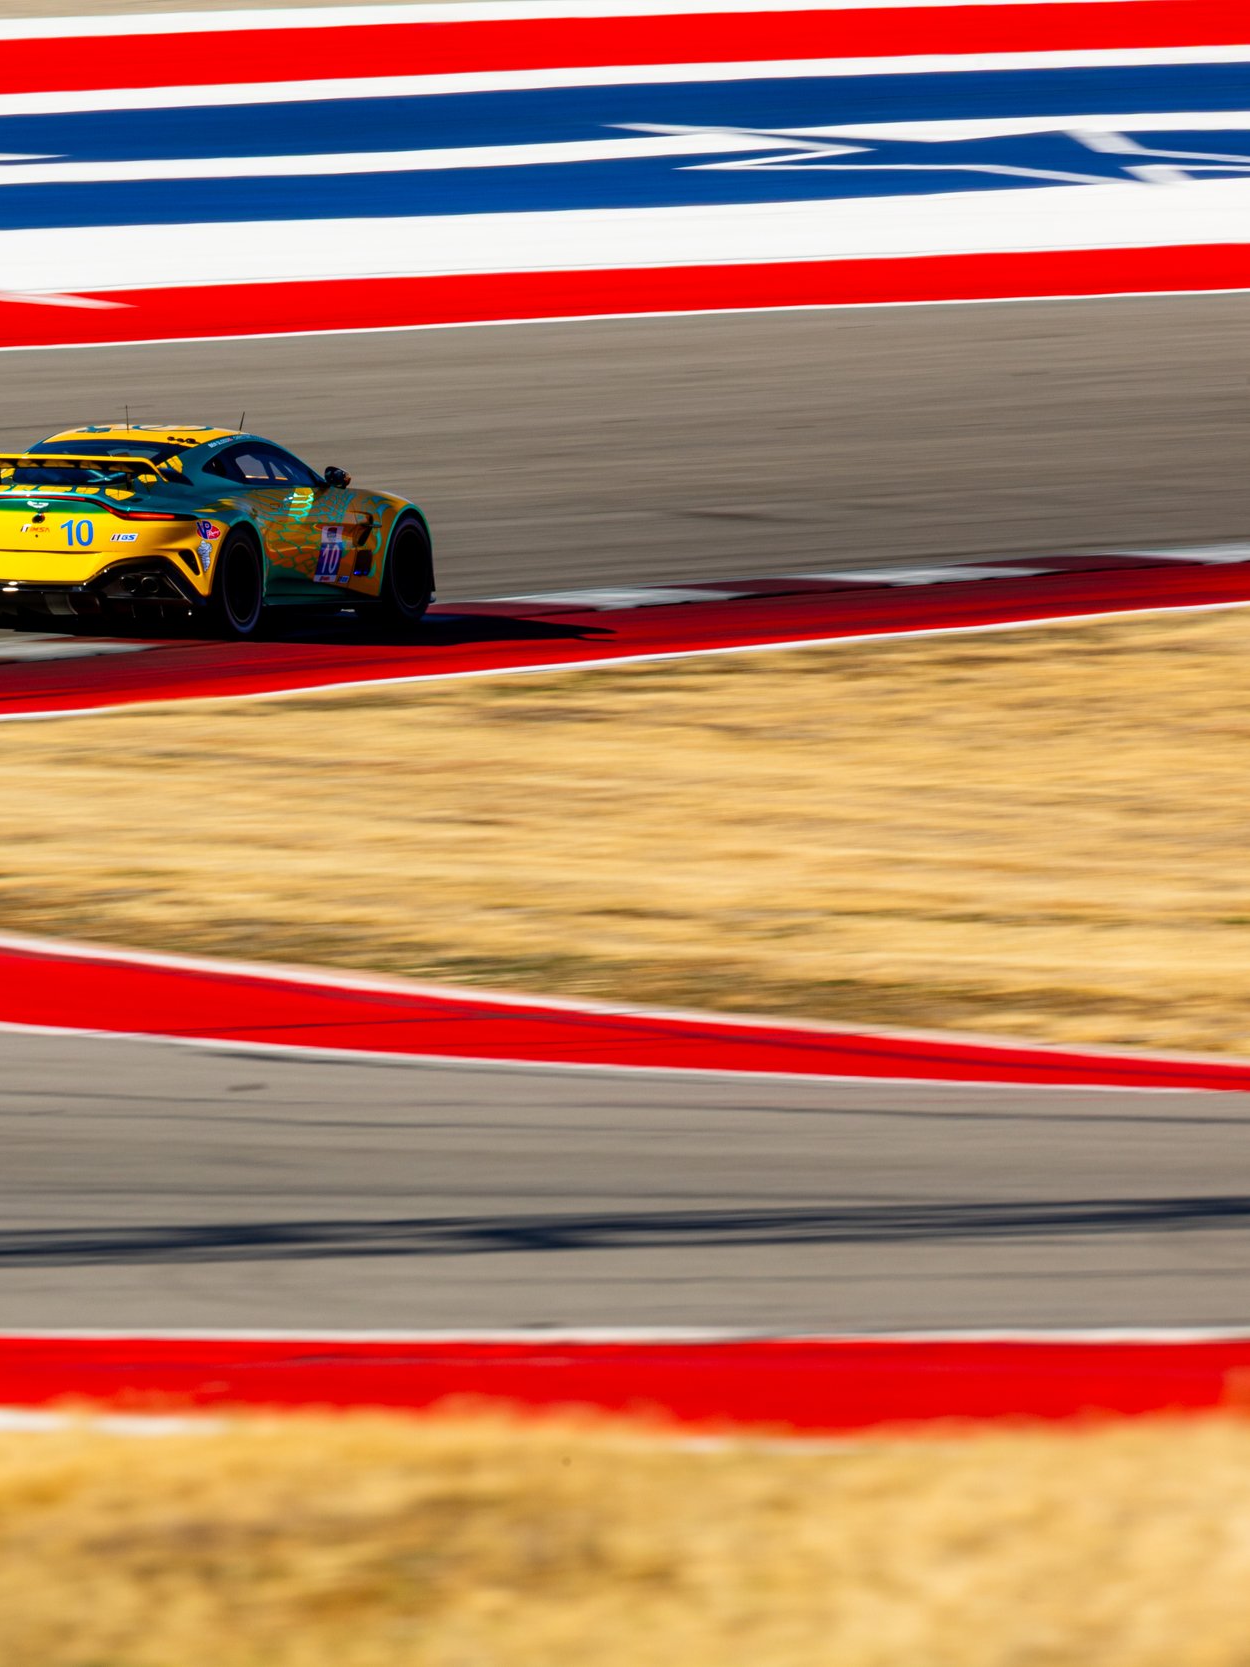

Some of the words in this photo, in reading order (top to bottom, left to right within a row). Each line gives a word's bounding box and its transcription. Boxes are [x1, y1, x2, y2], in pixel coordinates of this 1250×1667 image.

[61, 520, 94, 546] 10
[196, 521, 211, 539] VP
[323, 544, 340, 573] 10
